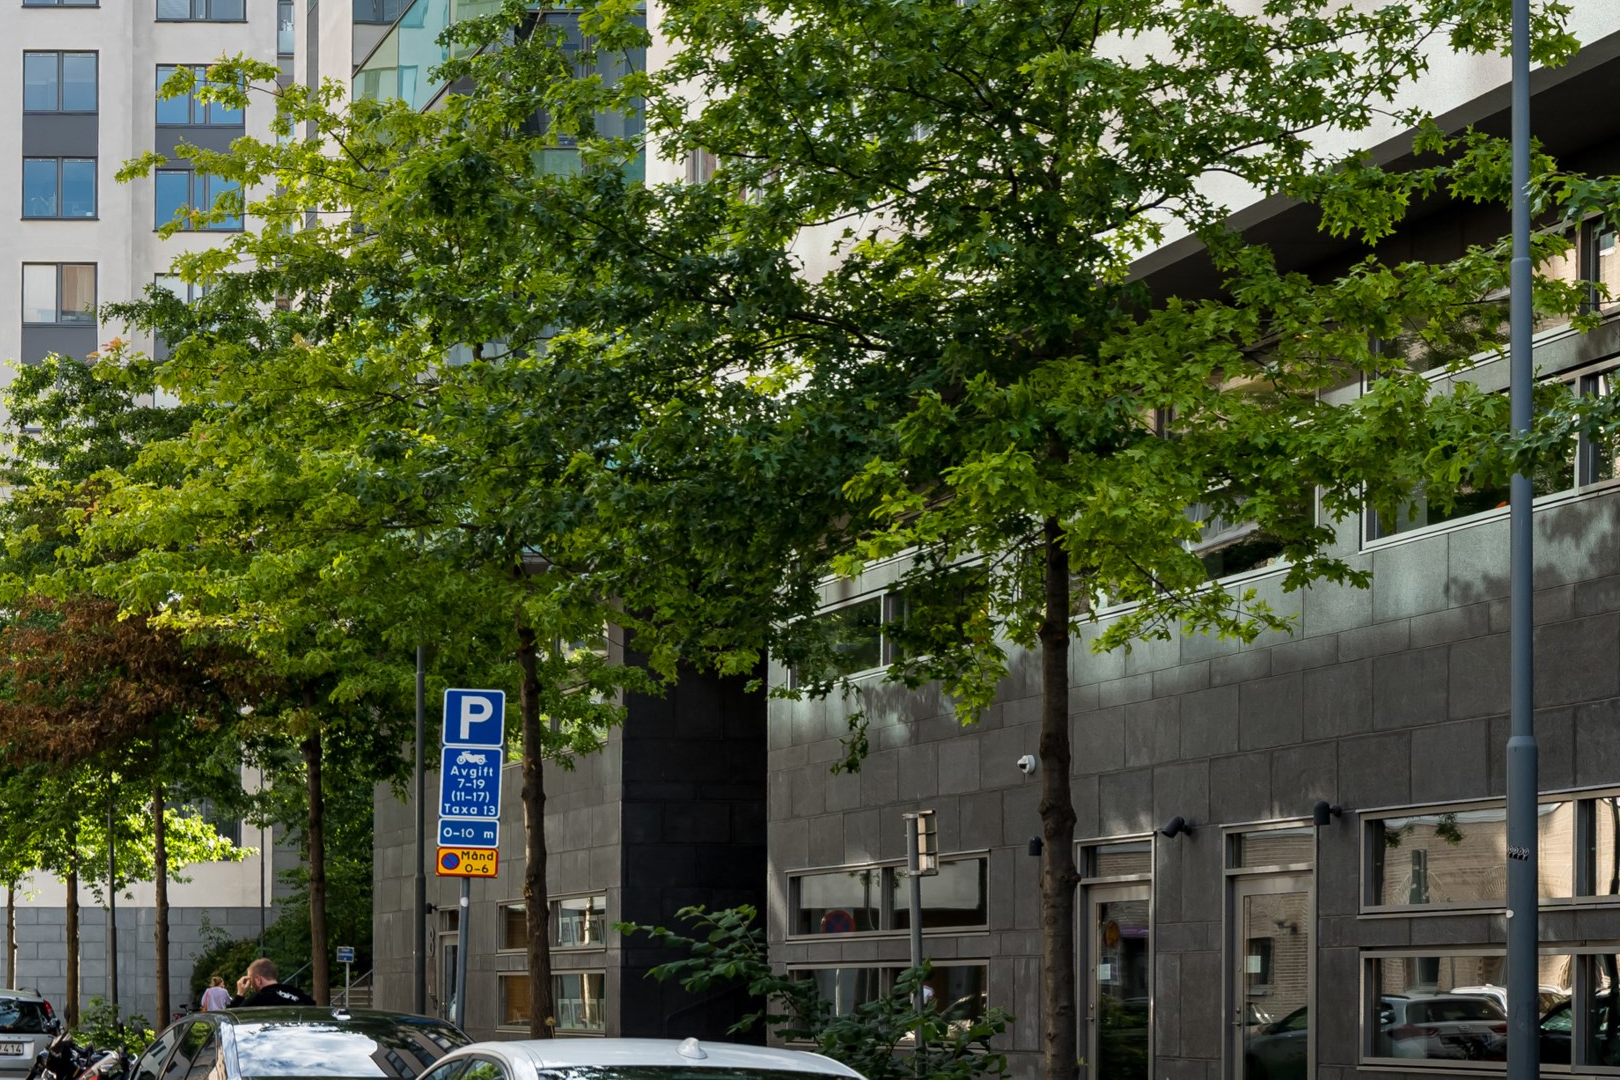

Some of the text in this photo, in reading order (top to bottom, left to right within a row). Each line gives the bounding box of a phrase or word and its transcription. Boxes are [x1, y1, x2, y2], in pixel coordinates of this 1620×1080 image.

[460, 695, 493, 739] P
[450, 765, 493, 778] Avgift
[457, 779, 485, 789] 7-19
[451, 791, 490, 803] (11-17)
[444, 804, 496, 815] Taxa 13
[443, 828, 494, 839] 0-10 m
[461, 850, 494, 861] Månd
[464, 863, 489, 873] 0-6
[4, 1042, 21, 1052] 414
